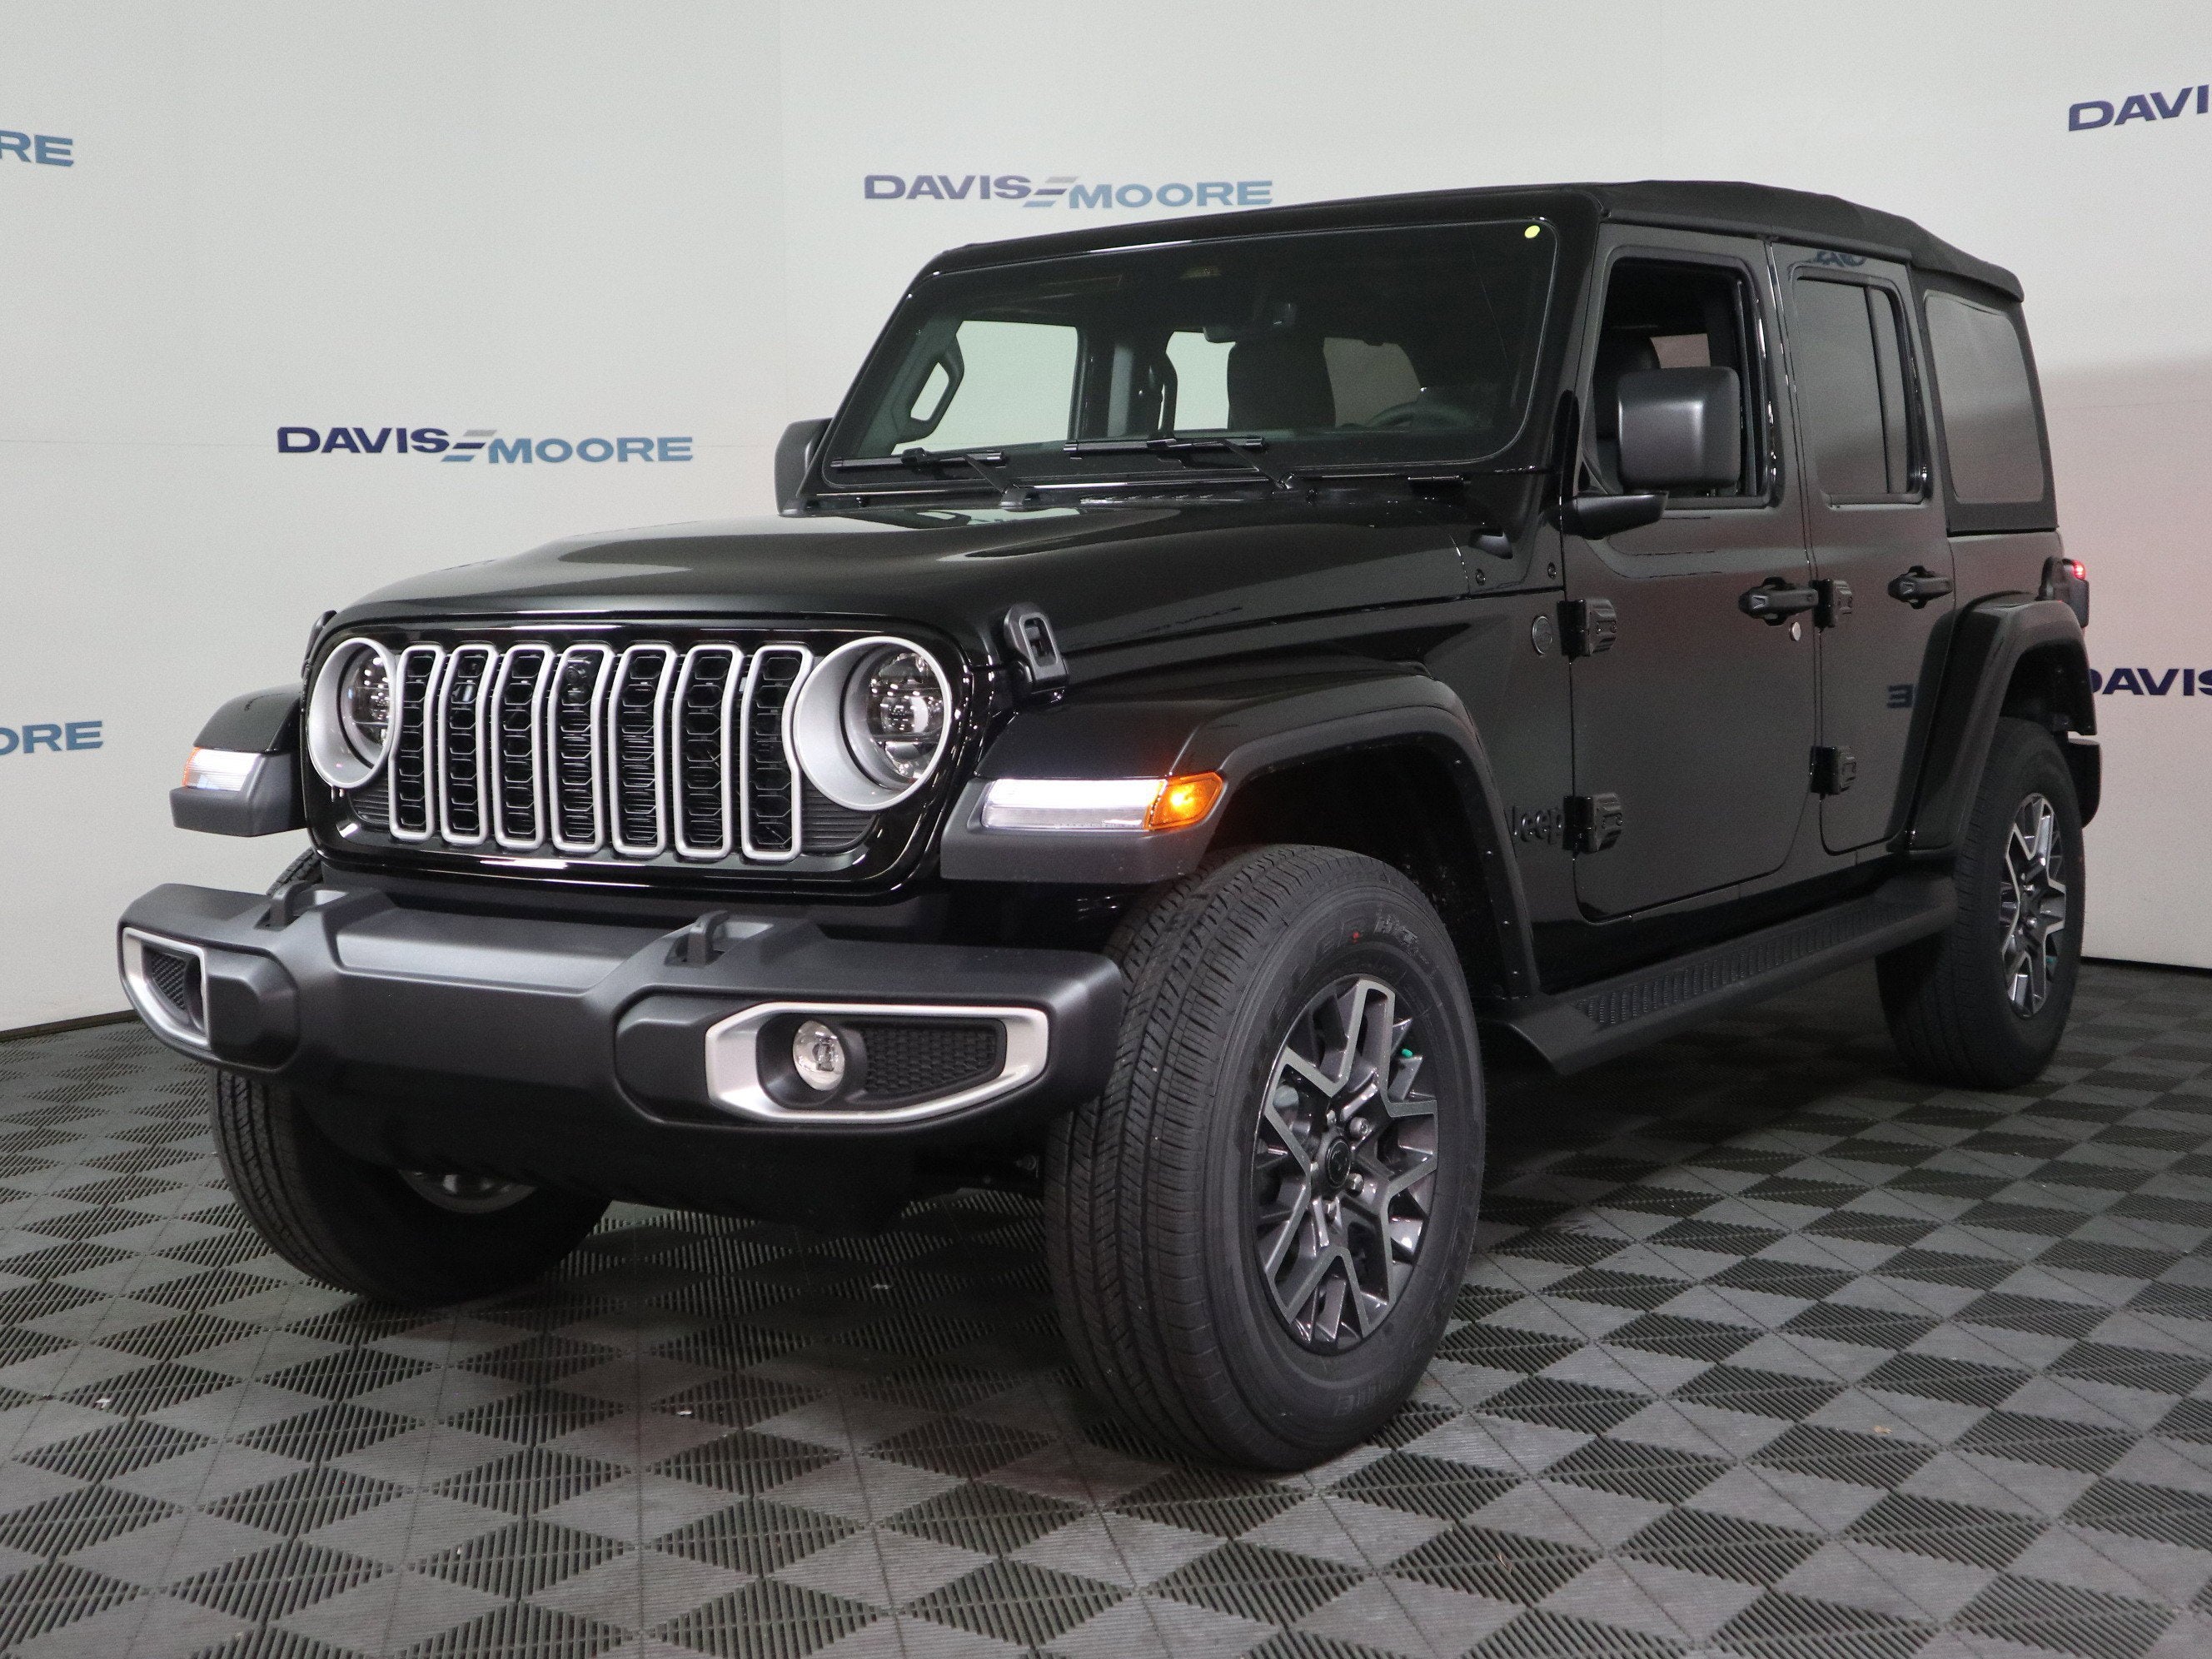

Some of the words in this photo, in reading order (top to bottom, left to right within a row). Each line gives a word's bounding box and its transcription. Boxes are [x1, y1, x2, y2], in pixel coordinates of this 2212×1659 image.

[864, 174, 1033, 201] DAVIS
[1067, 180, 1273, 210] MOORE
[276, 426, 451, 454] DAVIS
[486, 436, 694, 465] MOORE
